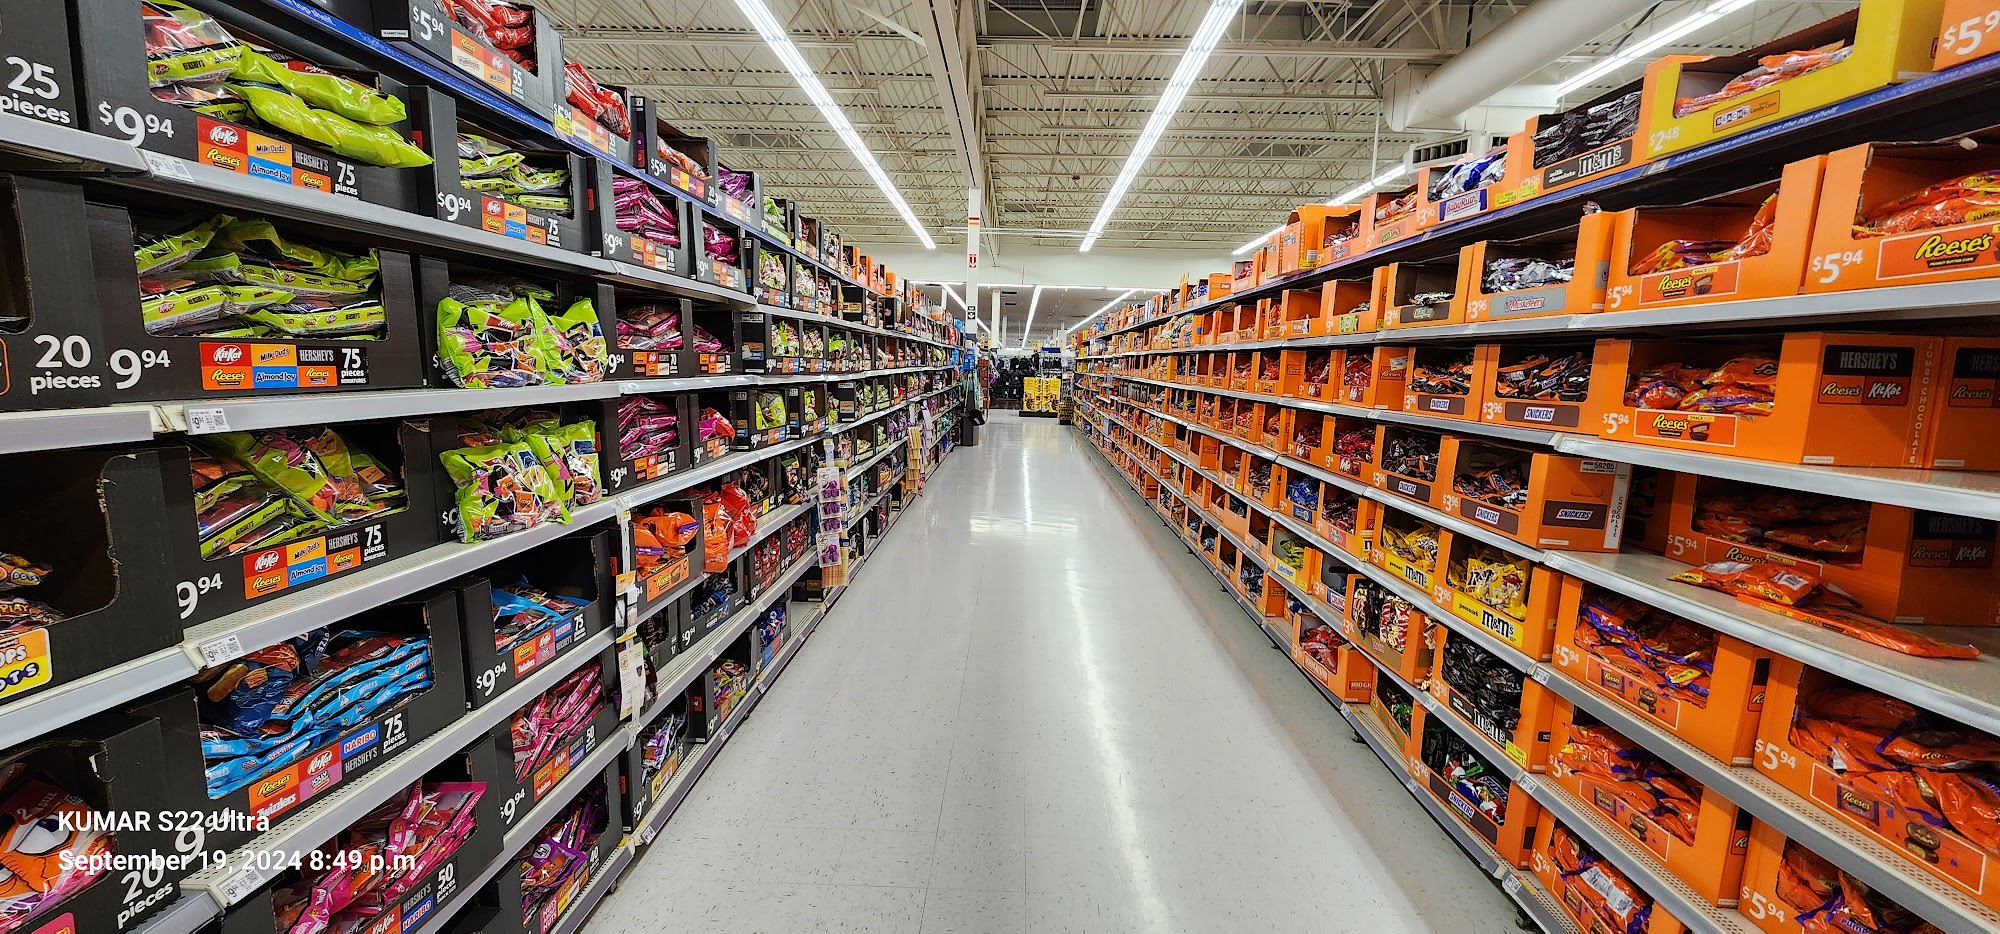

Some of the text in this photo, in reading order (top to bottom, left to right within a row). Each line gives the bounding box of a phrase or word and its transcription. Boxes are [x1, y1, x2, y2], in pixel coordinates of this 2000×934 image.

[5, 56, 60, 100] 25
[513, 68, 522, 86] 55
[207, 148, 240, 168] Reese's
[295, 151, 329, 172] HERSHEY'S
[251, 163, 292, 182] Almond Joy
[337, 161, 356, 185] 75
[1549, 171, 1576, 183] chocolate
[335, 183, 358, 195] pieces
[547, 217, 558, 236] 75
[1914, 234, 1994, 260] Reese's
[1657, 275, 1693, 291] Reese's
[34, 335, 92, 368] 20
[260, 347, 290, 362] Milk Duds
[300, 349, 334, 362] HERSHEY'S
[341, 348, 361, 368] 75
[1840, 351, 1898, 370] HERSHEY'S
[212, 369, 245, 382] Reese's
[256, 371, 296, 382] Almond Joy
[341, 368, 364, 378] pieces
[30, 371, 101, 395] pieces
[1822, 382, 1862, 396] Reese's
[1953, 386, 1991, 399] Reese's
[1431, 400, 1449, 409] SNICKERS
[1910, 343, 1933, 464] JUMBO CHOCOLATE
[1525, 408, 1553, 420] SNICKERS
[1653, 413, 1689, 431] Reese's
[1594, 462, 1615, 470] 59205
[1399, 481, 1416, 494] SNICKERS
[1476, 507, 1500, 524] SNICKERS
[1558, 510, 1591, 519] SNICKERS
[328, 532, 359, 550] HERSHEY'S
[364, 525, 382, 546] 75
[294, 547, 307, 560] Milk
[364, 543, 385, 555] pieces
[1725, 547, 1768, 564] Reese's
[1914, 548, 1950, 559] Reese's
[290, 562, 325, 581] Almond Joy
[252, 574, 282, 588] Reese's
[1458, 603, 1479, 617] peanut
[574, 613, 584, 631] 75
[384, 713, 402, 739] 75
[586, 725, 595, 743] 50
[344, 730, 377, 753] HARIBO
[383, 731, 406, 749] pieces
[345, 746, 378, 774] HERSHEY'S
[258, 774, 291, 797] Reese's
[1450, 792, 1475, 818] SNICKERS
[1843, 792, 1871, 811] Reese's
[438, 863, 454, 890] 50
[403, 883, 431, 914] HERSHEY'S
[437, 878, 456, 901] pieces
[117, 881, 173, 929] pieces
[402, 900, 431, 931] HARIBO
